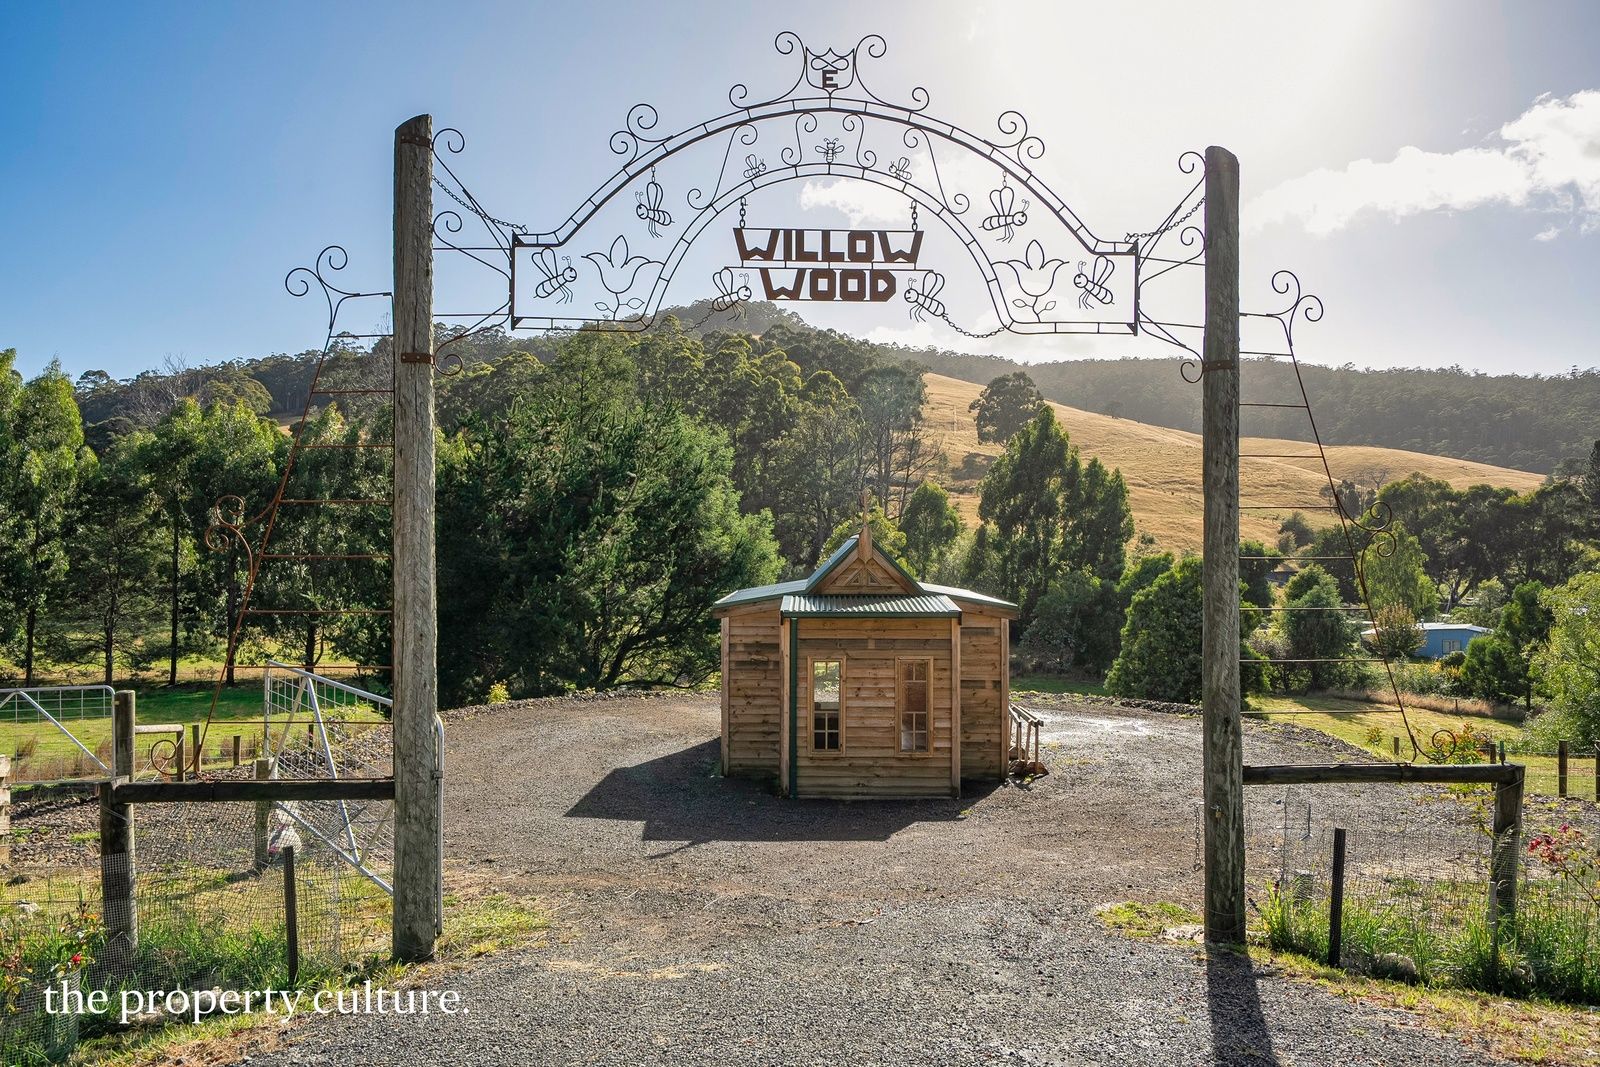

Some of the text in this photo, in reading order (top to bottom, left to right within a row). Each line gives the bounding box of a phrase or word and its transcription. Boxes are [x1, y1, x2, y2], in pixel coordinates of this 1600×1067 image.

[822, 70, 838, 88] E
[733, 228, 924, 263] WILLOW
[759, 268, 896, 302] WOOD
